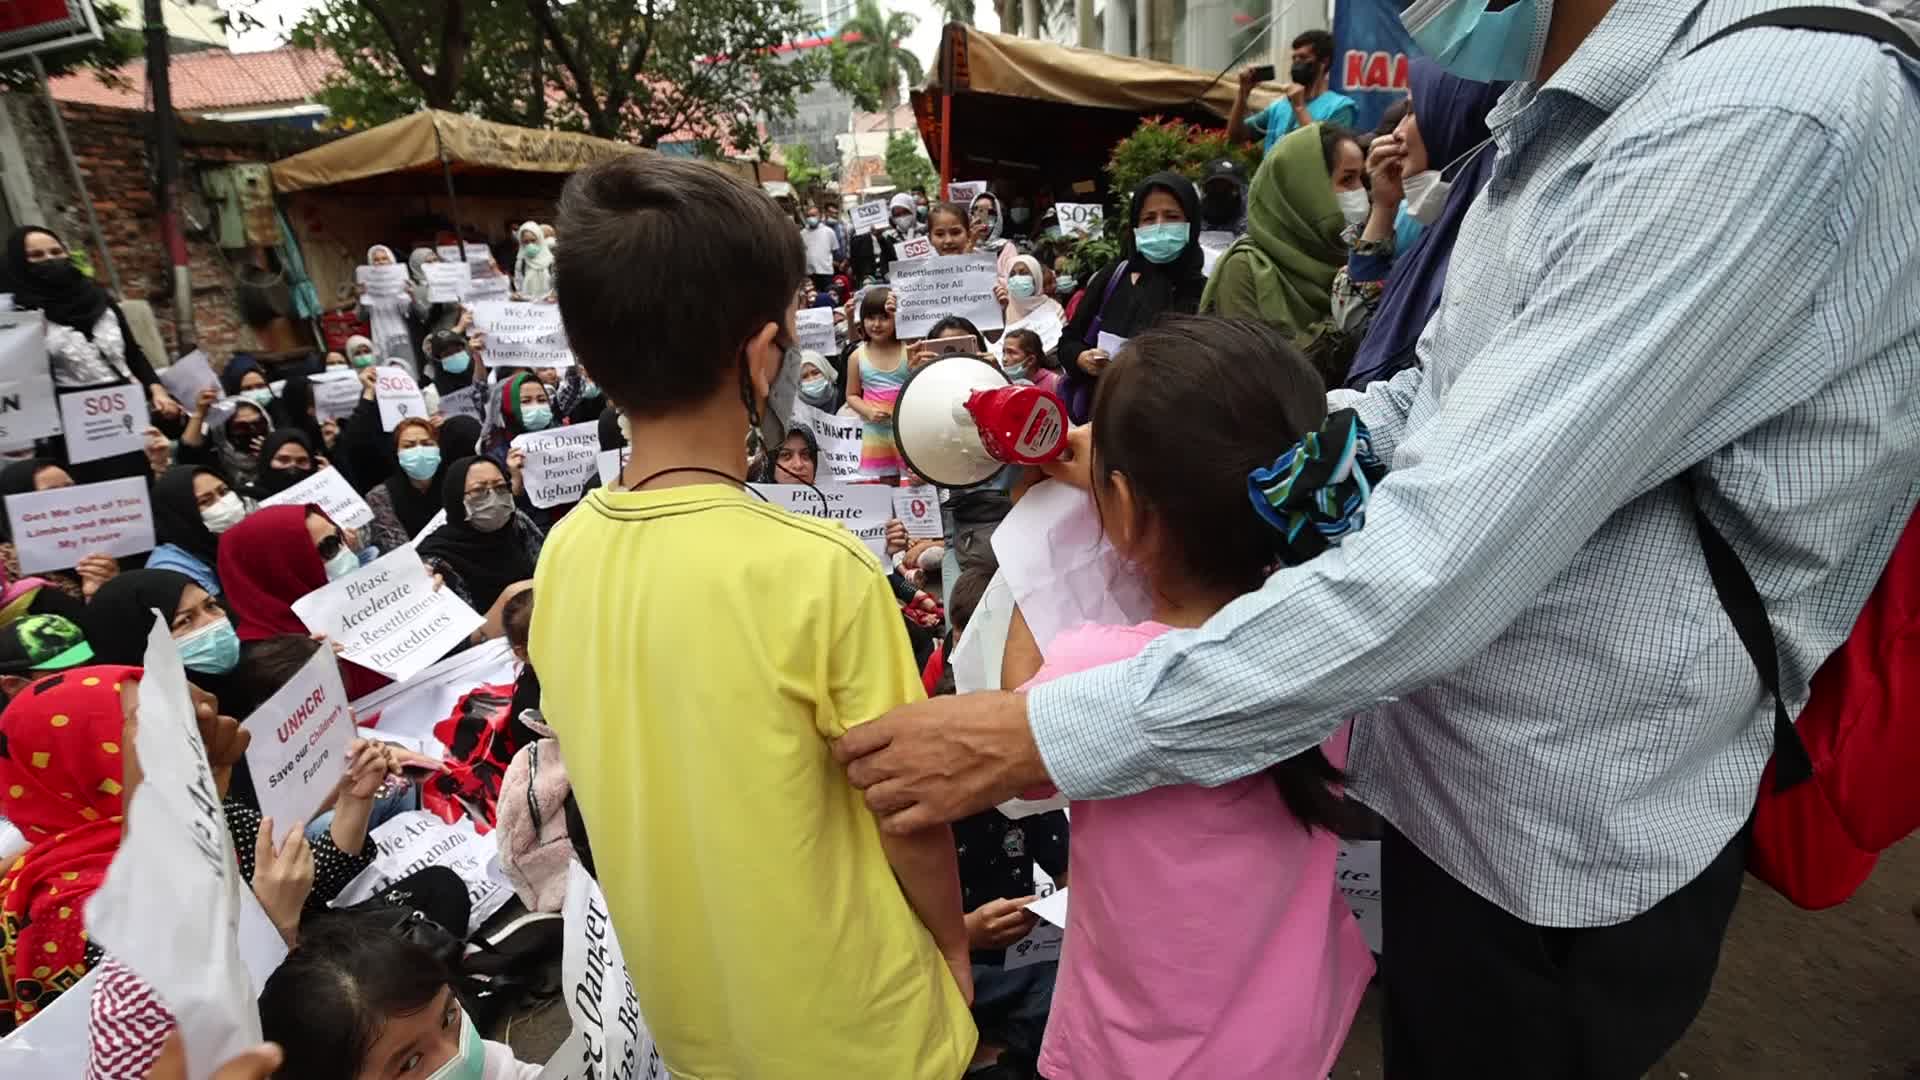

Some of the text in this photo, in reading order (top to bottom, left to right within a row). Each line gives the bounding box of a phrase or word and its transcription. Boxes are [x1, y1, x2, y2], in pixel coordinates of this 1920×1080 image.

[905, 241, 930, 257] SOS
[897, 267, 953, 279] Resettlement
[965, 264, 984, 273] Only
[936, 282, 950, 290] For
[901, 299, 939, 308] Concerns
[953, 294, 992, 303] Refugees
[504, 308, 545, 318] We Are
[487, 349, 567, 359] Humanitarian
[379, 376, 414, 391] SOS
[84, 393, 126, 416] SOS
[822, 421, 853, 440] WANT
[526, 433, 597, 454] Life Dange
[543, 450, 593, 466] Has Been
[544, 464, 583, 480] Proved
[792, 490, 844, 502] Please
[81, 532, 121, 543] Future
[345, 570, 389, 601] Please
[341, 583, 412, 633] Accelerate
[370, 611, 451, 670] Procedures
[276, 685, 326, 744] UNHCR!
[269, 761, 295, 789] Save
[295, 743, 309, 763] our
[303, 749, 329, 784] Future
[376, 836, 406, 857] We
